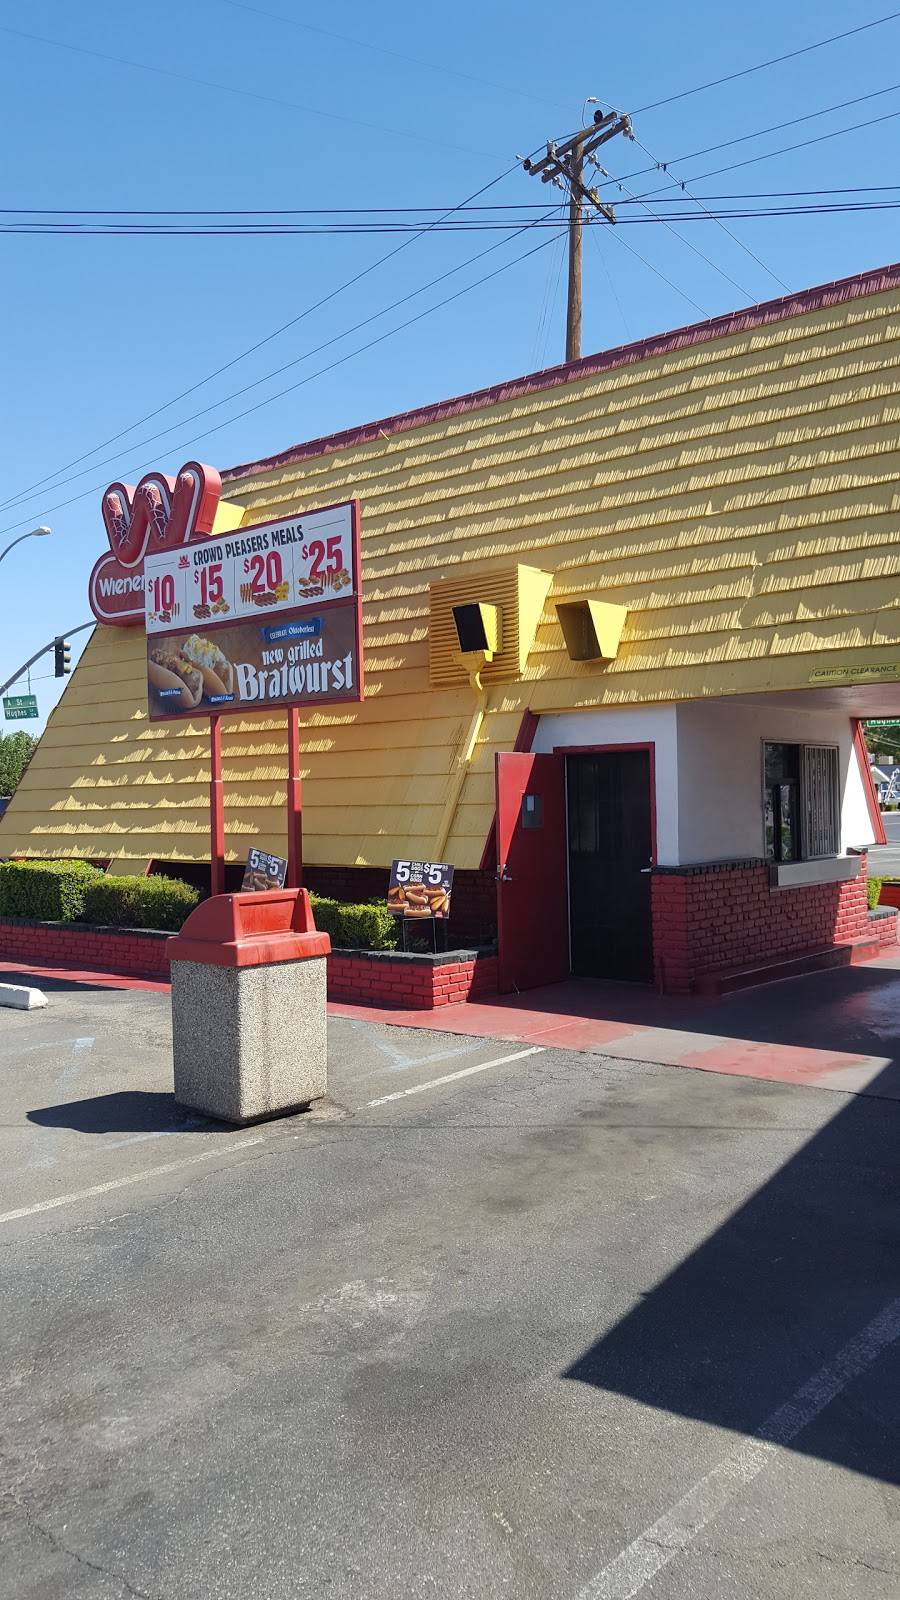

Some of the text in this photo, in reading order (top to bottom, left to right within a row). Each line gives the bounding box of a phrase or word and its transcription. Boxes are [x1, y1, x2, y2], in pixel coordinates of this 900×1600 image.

[193, 524, 304, 566] CROWD PLEASERS MEALS
[301, 535, 343, 578] $25
[193, 563, 224, 605] $15
[243, 550, 283, 593] $20
[148, 574, 175, 612] $10
[262, 637, 323, 666] new grilled
[233, 651, 353, 701] Bratwurst
[850, 665, 896, 675] CLEARANCE
[250, 849, 260, 868] 5
[267, 855, 279, 876] $5
[396, 861, 411, 882] 5
[423, 862, 443, 884] $5
